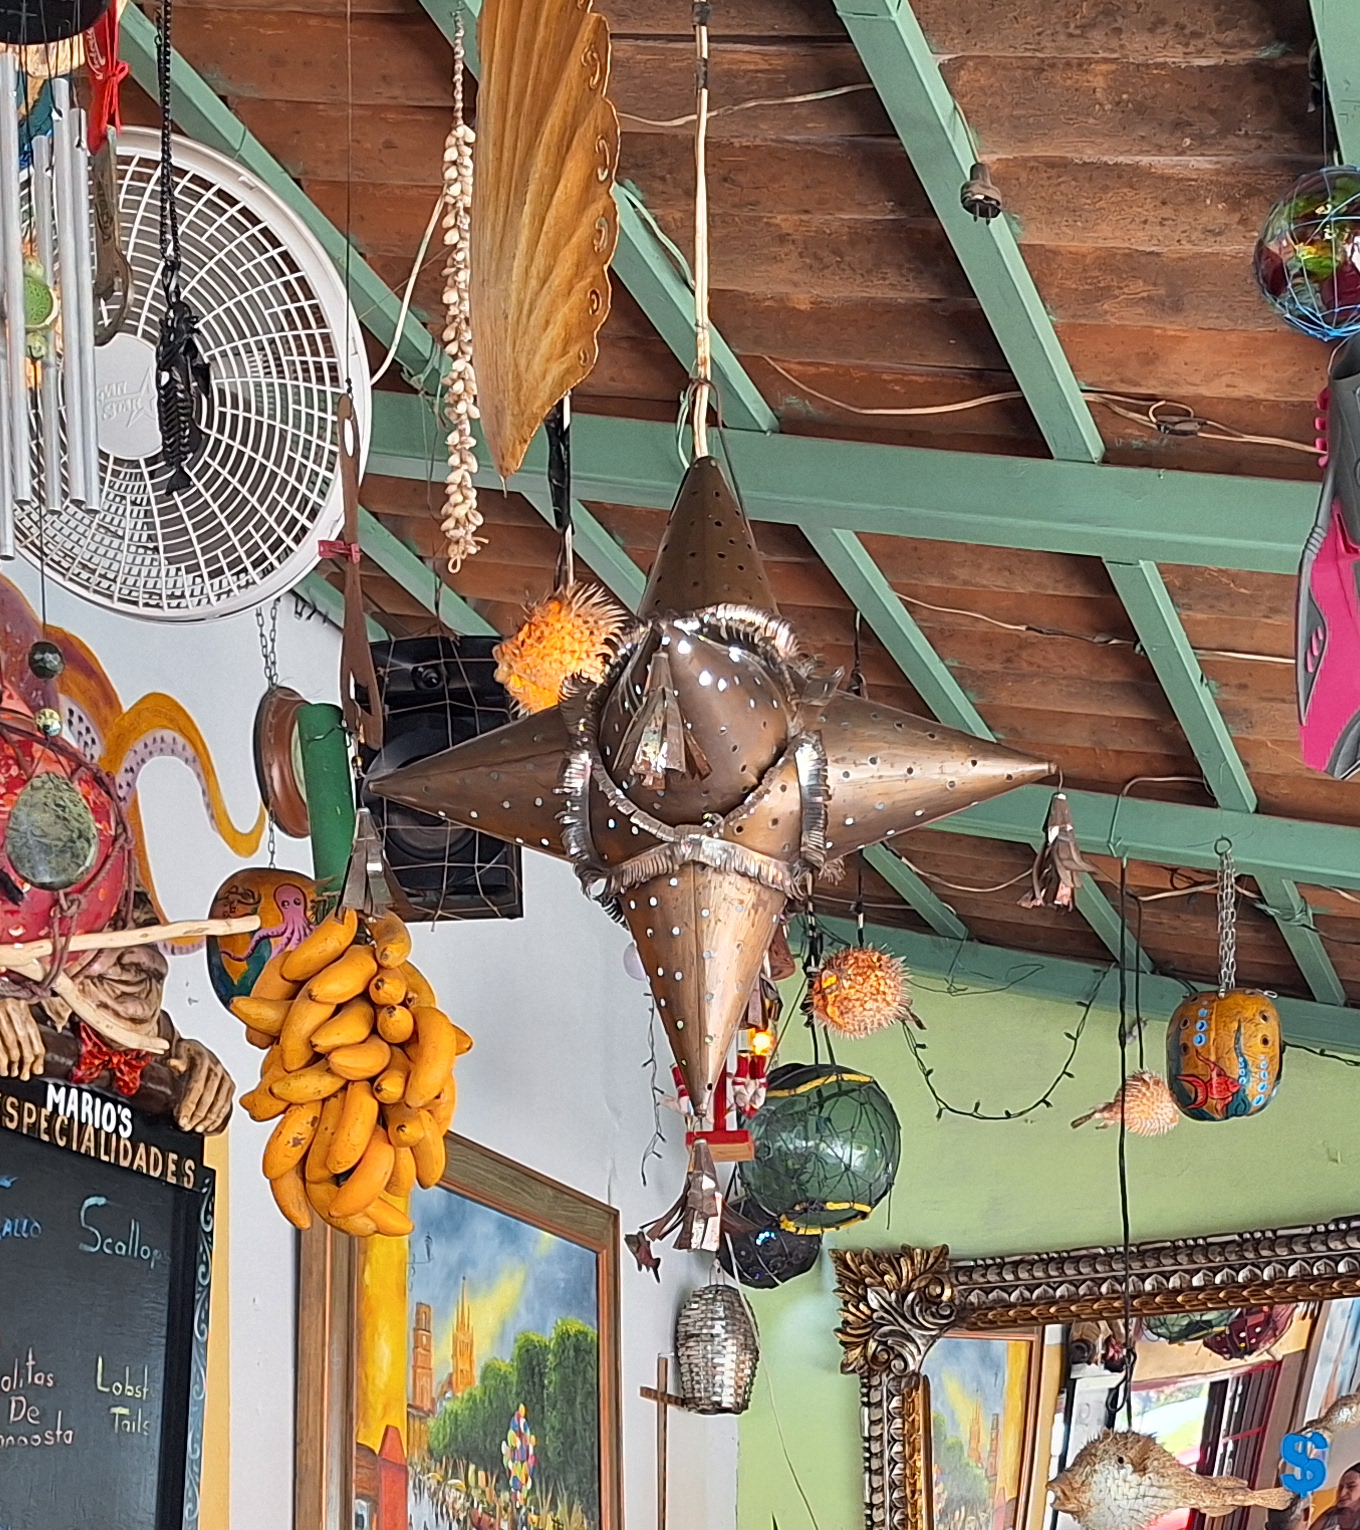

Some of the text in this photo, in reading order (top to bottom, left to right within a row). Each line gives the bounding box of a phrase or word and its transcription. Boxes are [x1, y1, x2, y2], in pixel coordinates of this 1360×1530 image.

[46, 1083, 133, 1138] MARIO'S
[9, 1396, 41, 1425] De
[109, 1405, 151, 1437] Tails
